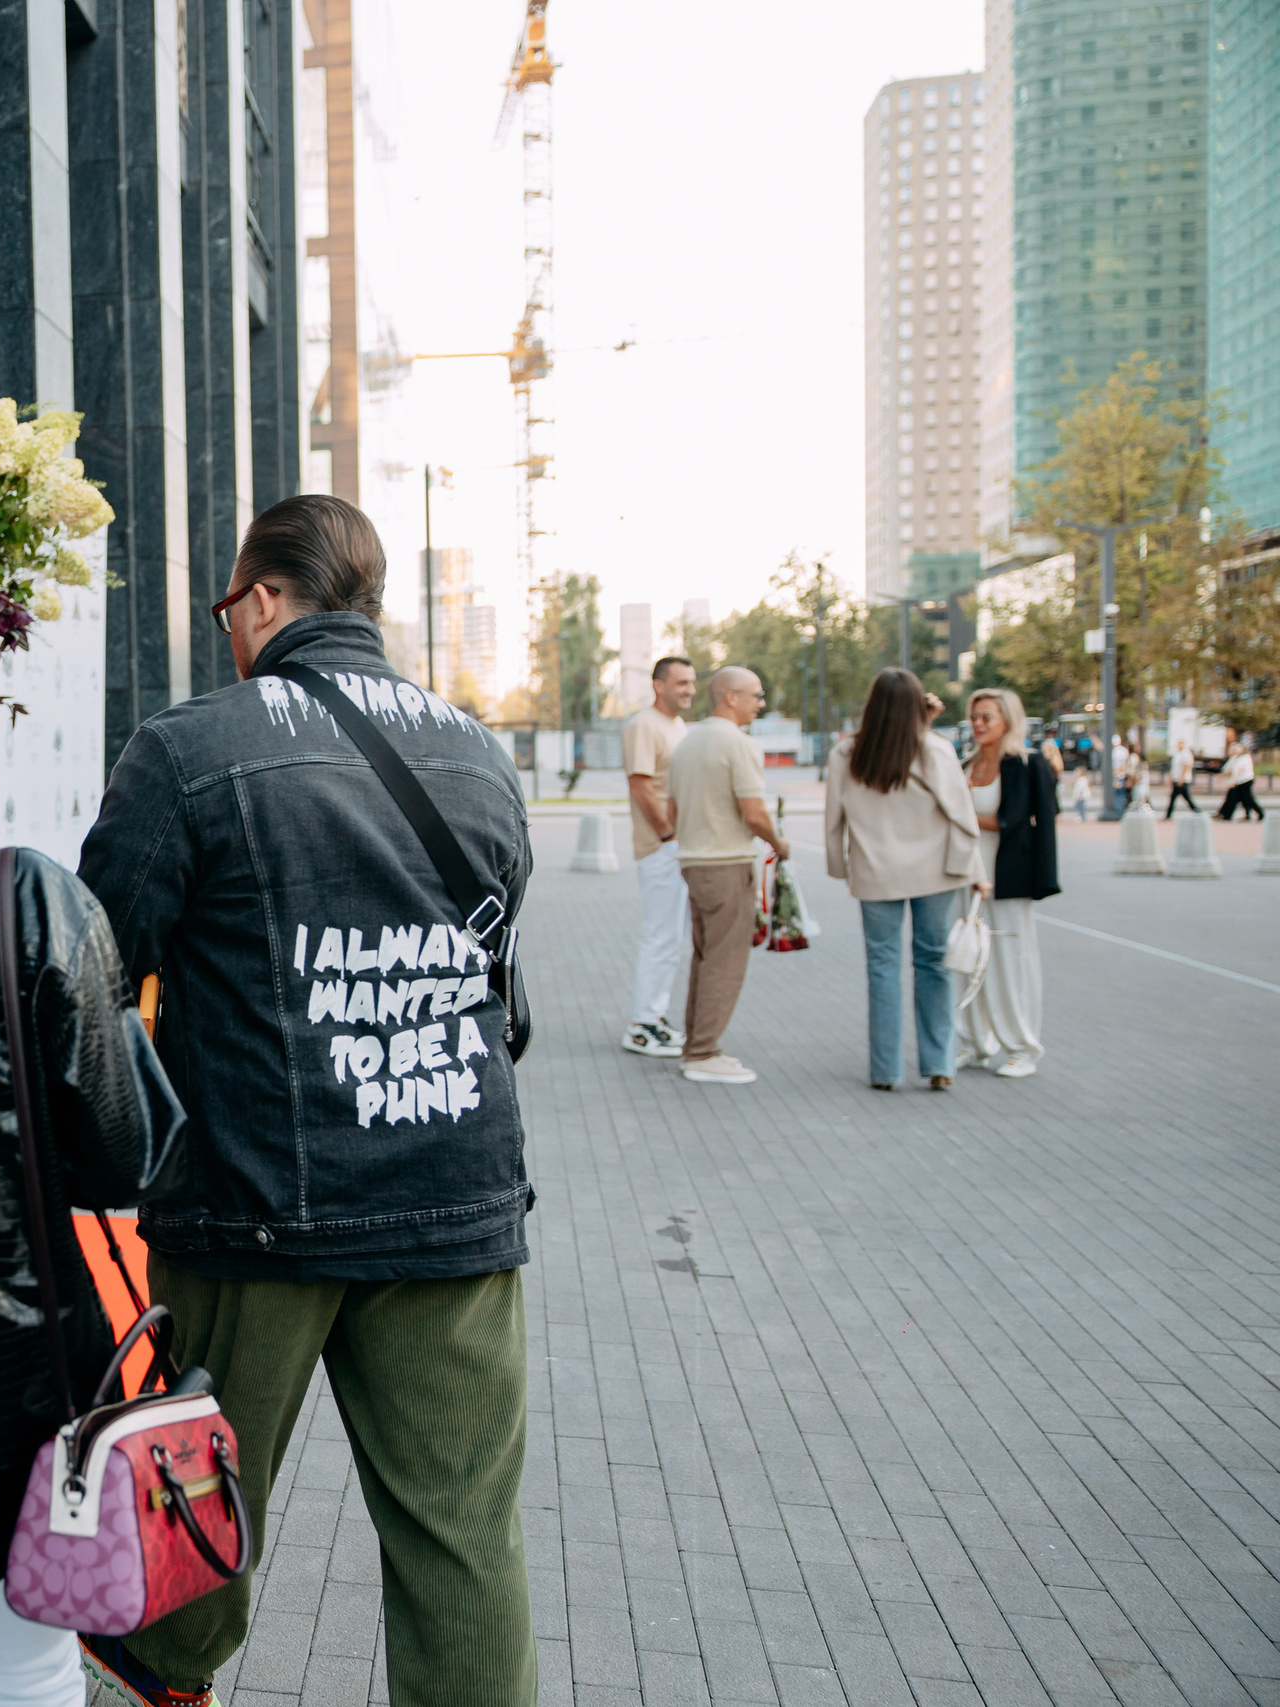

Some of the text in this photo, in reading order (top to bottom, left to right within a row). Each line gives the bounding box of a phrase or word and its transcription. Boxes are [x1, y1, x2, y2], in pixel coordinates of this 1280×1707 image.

[257, 671, 488, 748] RIHMON
[293, 923, 308, 976] I
[307, 973, 489, 1026] WANTED
[329, 1016, 489, 1084] TO BE A
[356, 1066, 480, 1129] PUNK
